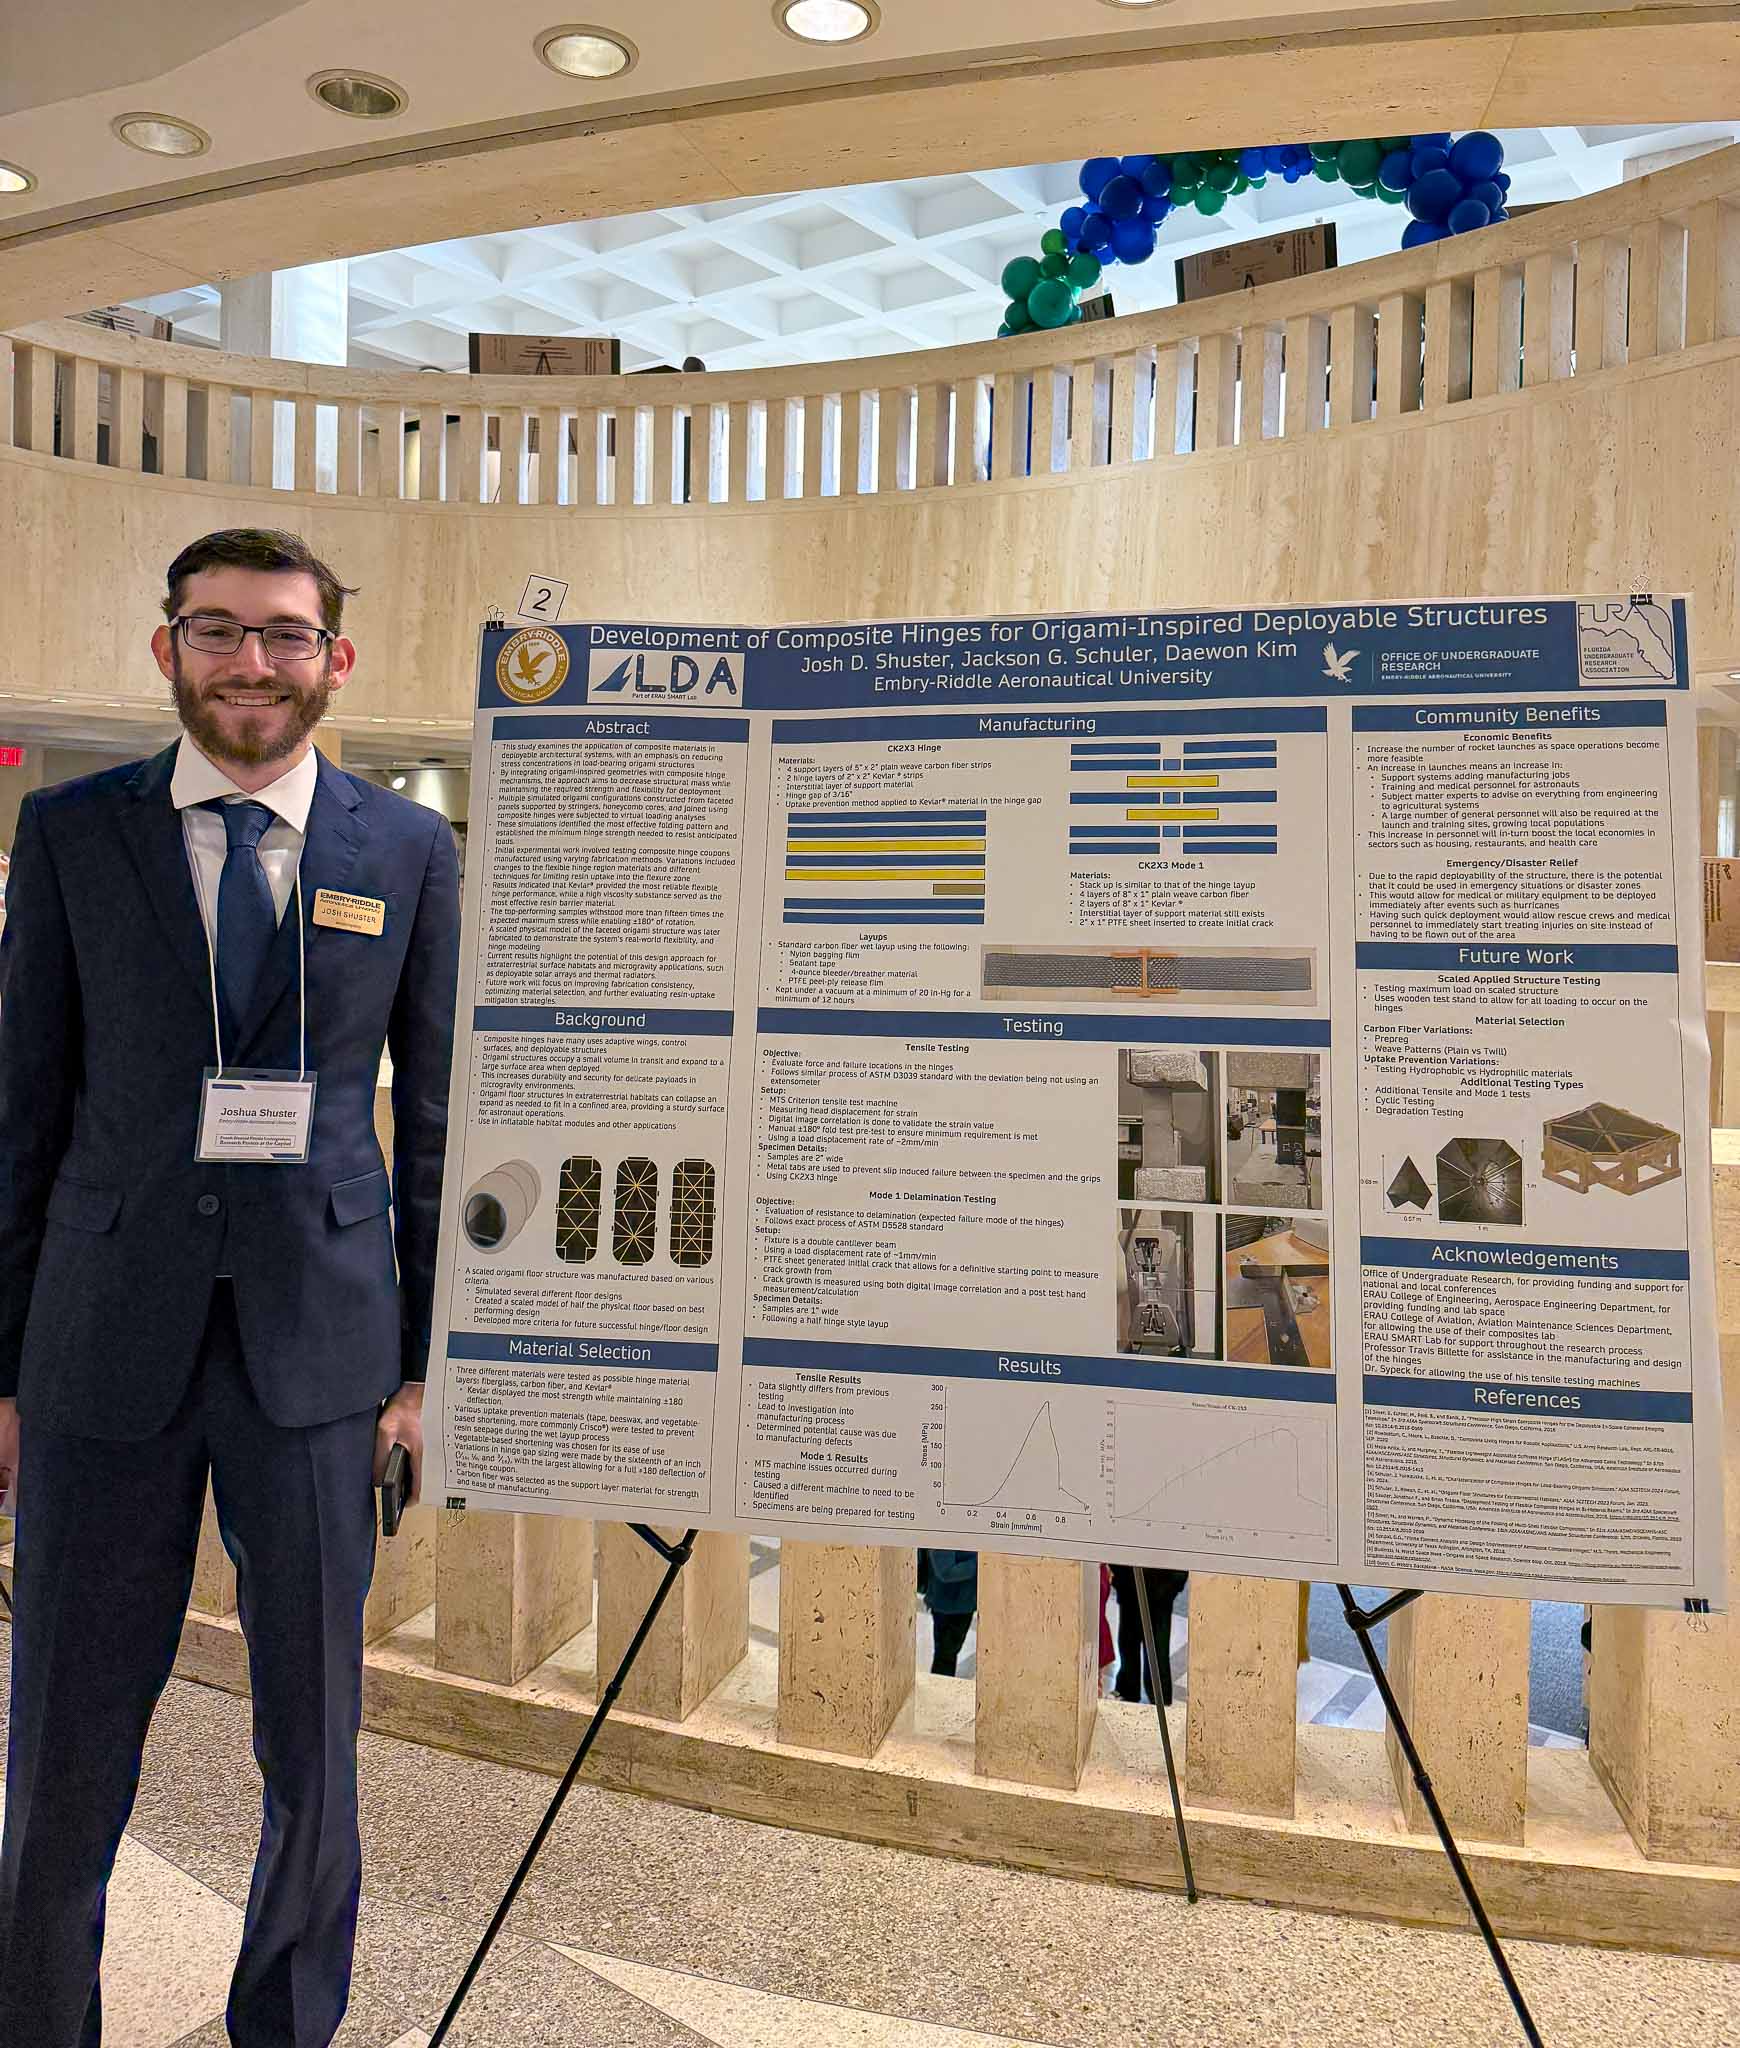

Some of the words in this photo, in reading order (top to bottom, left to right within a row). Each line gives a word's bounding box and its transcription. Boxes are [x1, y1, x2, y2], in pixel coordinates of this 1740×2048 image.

[532, 588, 552, 612] 2
[590, 625, 740, 650] Development
[746, 630, 770, 649] of
[776, 626, 893, 651] Composite
[902, 623, 982, 647] Hinges
[989, 622, 1024, 642] for
[1031, 612, 1242, 644] Origami-Inspired
[1253, 607, 1397, 636] Deployable
[1407, 605, 1548, 627] Structures
[500, 629, 567, 665] EMBRY-RIDDLE
[800, 655, 843, 673] Josh
[850, 654, 868, 671] D.
[875, 651, 954, 670] Shuster,
[960, 650, 1040, 667] Jackson
[1047, 648, 1067, 665] G.
[1075, 645, 1157, 664] Schuler,
[1165, 644, 1248, 661] Daewon
[1256, 640, 1297, 658] Kim
[1380, 651, 1421, 662] OFFICE
[1422, 651, 1439, 661] OF
[1440, 648, 1540, 660] UNDERGRADUATE
[1381, 661, 1441, 672] RESEARCH
[874, 673, 992, 693] Embry-Riddle
[997, 669, 1113, 688] Aeronautical
[1119, 667, 1213, 687] University
[1415, 707, 1519, 726] Community
[1525, 705, 1601, 722] Benefits
[584, 720, 650, 735] Abstract
[979, 716, 1096, 733] Manufacturing
[1463, 732, 1510, 742] Economic
[1511, 732, 1553, 741] Benefits
[501, 743, 516, 751] This
[517, 743, 537, 751] study
[571, 742, 583, 750] the
[584, 742, 623, 750] application
[633, 743, 671, 751] composite
[672, 744, 707, 752] materials
[708, 745, 715, 753] in
[917, 743, 942, 753] Hinge
[778, 756, 816, 765] Materials:
[1381, 773, 1415, 783] Support
[1416, 773, 1452, 783] systems
[1453, 771, 1484, 782] adding
[1485, 770, 1550, 780] manufacturing
[1551, 770, 1571, 780] jobs
[1171, 861, 1197, 870] Mode
[1198, 861, 1204, 870] 1
[1446, 858, 1548, 869] Emergency/Disaster
[1549, 858, 1579, 867] Relief
[1069, 871, 1111, 879] Materials:
[320, 891, 381, 910] EMBRY-RIDDLE
[321, 907, 342, 917] JOSH
[343, 911, 376, 924] SHUSTER
[859, 932, 888, 942] Layups
[1458, 947, 1520, 964] Future
[1525, 948, 1574, 965] Work
[788, 958, 817, 967] Sealant
[819, 960, 836, 969] tape
[1437, 974, 1470, 983] Scaled
[1472, 975, 1511, 985] Applied
[1512, 975, 1561, 985] Structure
[1562, 976, 1601, 987] Testing
[554, 1011, 646, 1030] Background
[1475, 1015, 1516, 1025] Material
[1518, 1016, 1565, 1027] Selection
[1002, 1017, 1064, 1037] Testing
[1363, 1023, 1396, 1033] Carbon
[1397, 1024, 1422, 1034] Fiber
[1422, 1025, 1473, 1035] Variations:
[1373, 1033, 1409, 1045] Prepreg
[762, 1048, 801, 1058] Objective:
[904, 1042, 936, 1052] Tensile
[936, 1043, 970, 1054] Testing
[1363, 1054, 1396, 1064] Uptake
[1398, 1054, 1448, 1065] Prevention
[1449, 1056, 1500, 1066] Variations:
[1459, 1077, 1512, 1088] Additional
[1513, 1078, 1551, 1090] Testing
[1552, 1079, 1584, 1090] Types
[760, 1085, 786, 1096] Setup:
[1374, 1095, 1400, 1106] Cyclic
[1402, 1096, 1435, 1108] Testing
[220, 1107, 257, 1117] Joshua
[258, 1108, 297, 1118] Shuster
[1375, 1105, 1429, 1116] Degradation
[1431, 1107, 1464, 1119] Testing
[477, 1116, 491, 1125] Use
[491, 1117, 499, 1125] in
[499, 1117, 535, 1126] inflatable
[535, 1118, 562, 1127] habitat
[563, 1119, 596, 1128] modules
[596, 1120, 611, 1128] and
[611, 1121, 632, 1129] other
[632, 1122, 677, 1130] applications
[757, 1141, 796, 1152] Specimen
[796, 1143, 827, 1153] Details:
[765, 1171, 788, 1182] Using
[816, 1173, 838, 1183] hinge
[755, 1196, 795, 1206] Objective:
[868, 1190, 893, 1200] Mode
[894, 1191, 902, 1200] 1
[903, 1191, 962, 1202] Delamination
[963, 1194, 997, 1206] Testing
[754, 1224, 781, 1236] Setup:
[1431, 1245, 1619, 1270] Acknowledgements
[752, 1292, 791, 1303] Specimen
[792, 1295, 823, 1305] Details:
[509, 1339, 574, 1358] Material
[577, 1342, 651, 1361] Selection
[998, 1356, 1061, 1375] Results
[456, 1365, 477, 1375] Three
[478, 1367, 510, 1377] different
[511, 1369, 546, 1379] materials
[547, 1372, 566, 1380] were
[566, 1372, 590, 1381] tested
[591, 1374, 601, 1382] as
[602, 1374, 634, 1383] possible
[634, 1375, 657, 1385] hinge
[658, 1377, 690, 1386] material
[795, 1372, 827, 1383] Tensile
[828, 1374, 862, 1385] Results
[1364, 1363, 1377, 1373] Dr.
[1379, 1364, 1411, 1375] Sypeck
[1413, 1366, 1426, 1376] for
[1428, 1367, 1466, 1380] allowing
[1468, 1370, 1483, 1379] the
[1485, 1372, 1502, 1380] use
[1503, 1372, 1513, 1381] of
[1515, 1373, 1529, 1382] his
[1530, 1374, 1561, 1384] tensile
[1563, 1376, 1595, 1387] testing
[1597, 1378, 1641, 1388] machines
[930, 1383, 944, 1392] 300
[1474, 1387, 1581, 1409] References
[930, 1402, 943, 1411] 250
[929, 1422, 943, 1430] 200
[930, 1441, 943, 1450] 150
[800, 1450, 825, 1461] Mode
[826, 1452, 833, 1461] 1
[834, 1452, 869, 1464] Results
[929, 1461, 942, 1469] 100
[932, 1480, 942, 1489] 50
[996, 1511, 1007, 1519] 0.4
[1025, 1513, 1037, 1521] 0.6
[1055, 1516, 1066, 1524] 0.8
[989, 1520, 1010, 1529] Strain
